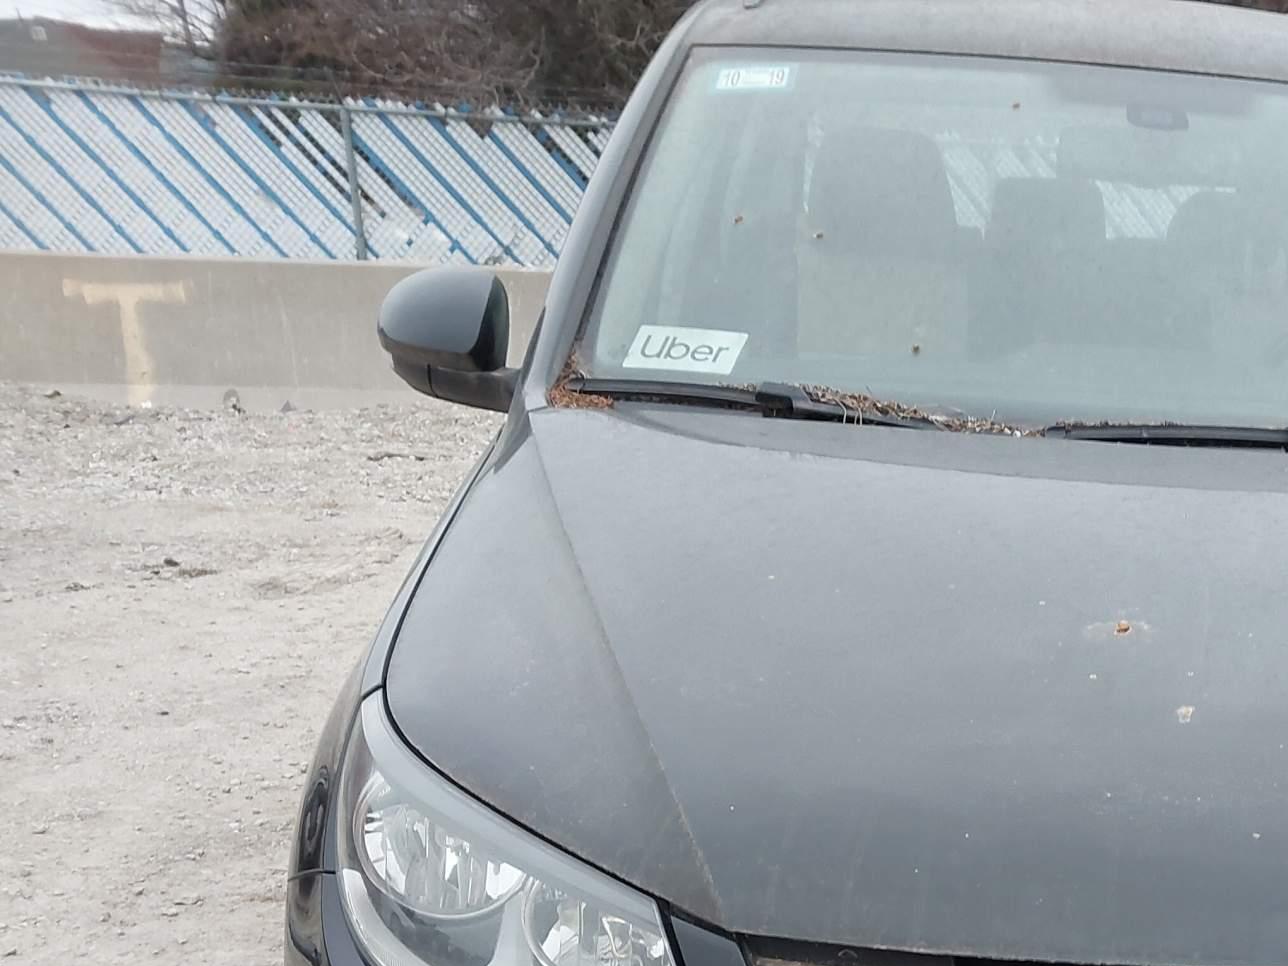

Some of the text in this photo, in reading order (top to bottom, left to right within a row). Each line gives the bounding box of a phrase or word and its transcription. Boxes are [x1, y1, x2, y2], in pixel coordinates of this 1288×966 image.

[723, 68, 785, 87] 10 19
[639, 334, 730, 363] Uber
